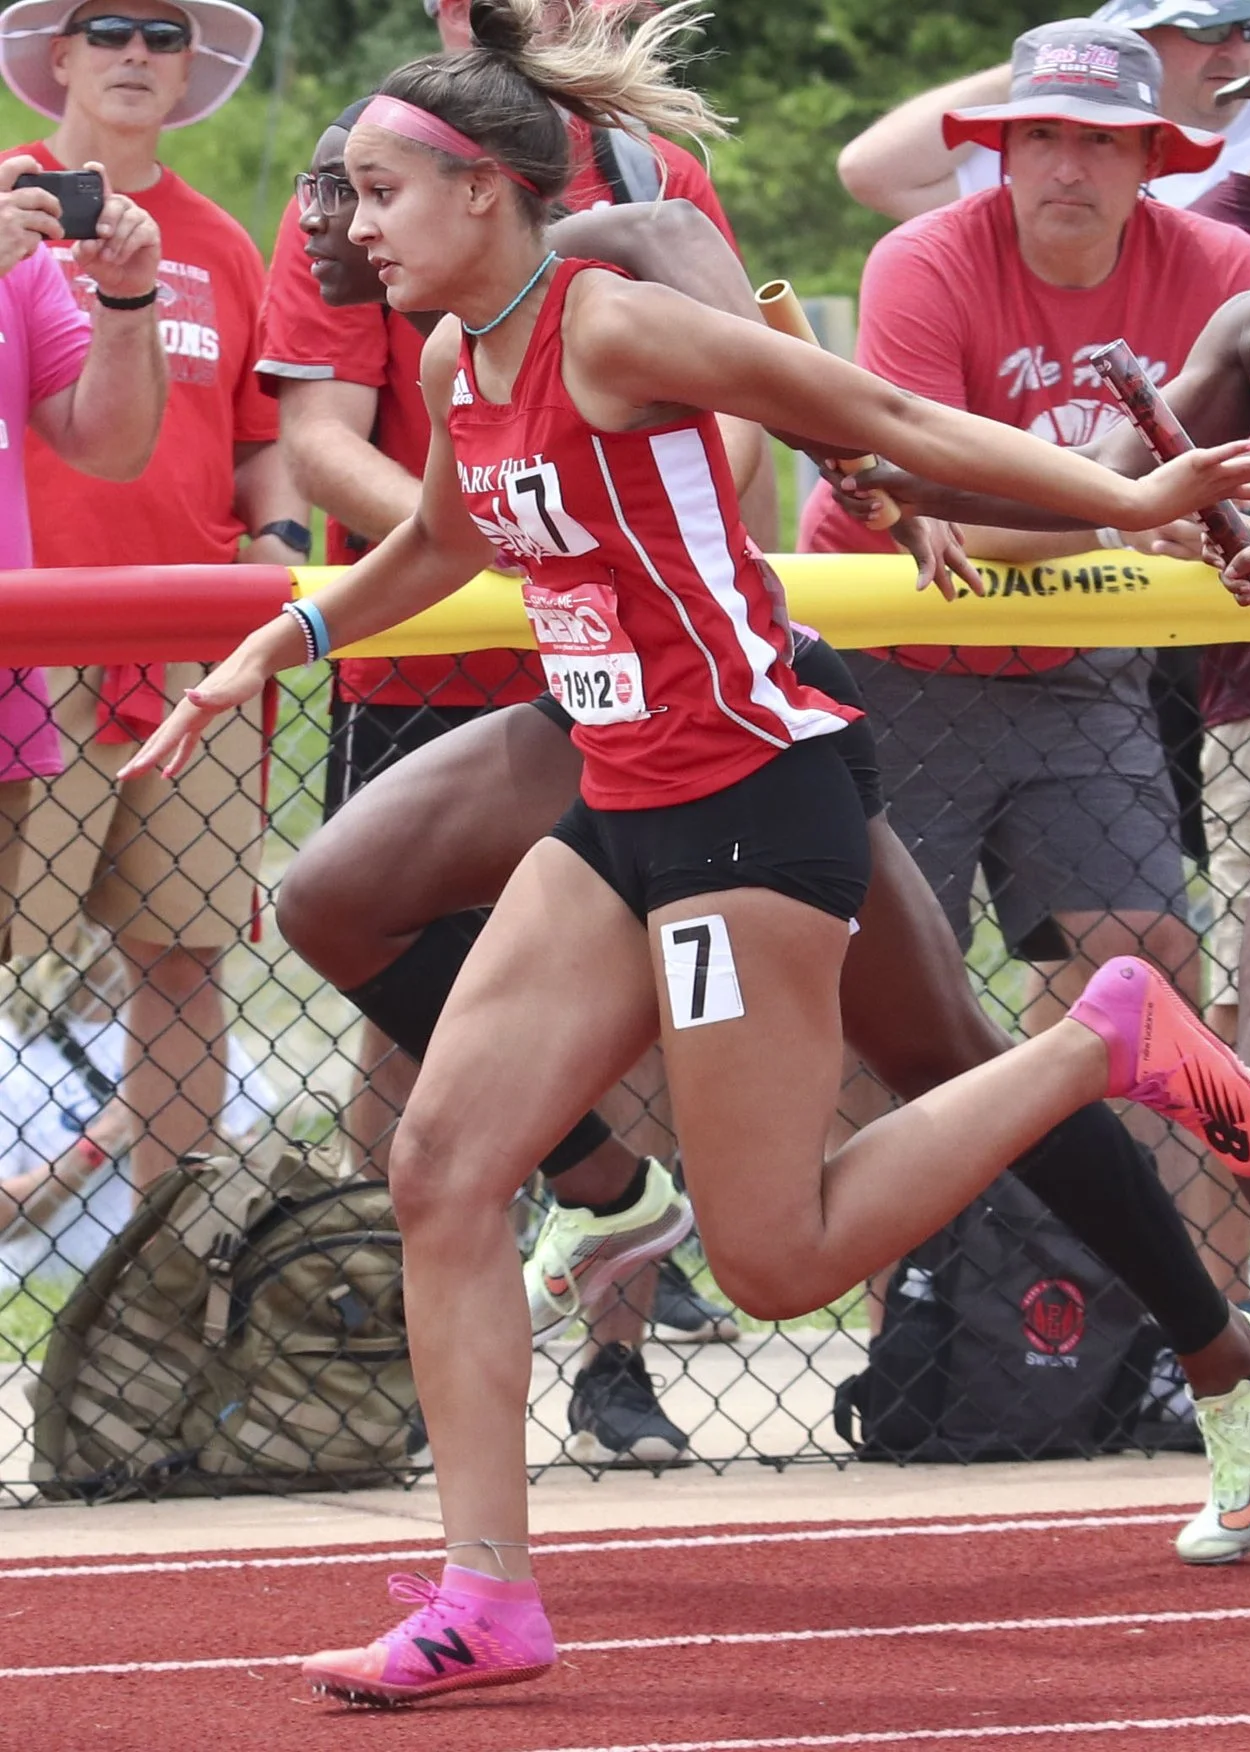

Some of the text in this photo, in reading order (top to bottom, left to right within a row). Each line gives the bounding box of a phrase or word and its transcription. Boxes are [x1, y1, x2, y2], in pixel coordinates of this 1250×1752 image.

[157, 319, 220, 361] ONS
[456, 459, 500, 495] PARK
[515, 473, 570, 553] 7
[524, 605, 612, 644] ZERO
[563, 668, 614, 709] 1912
[672, 923, 712, 1020] 7
[411, 1626, 477, 1674] N
